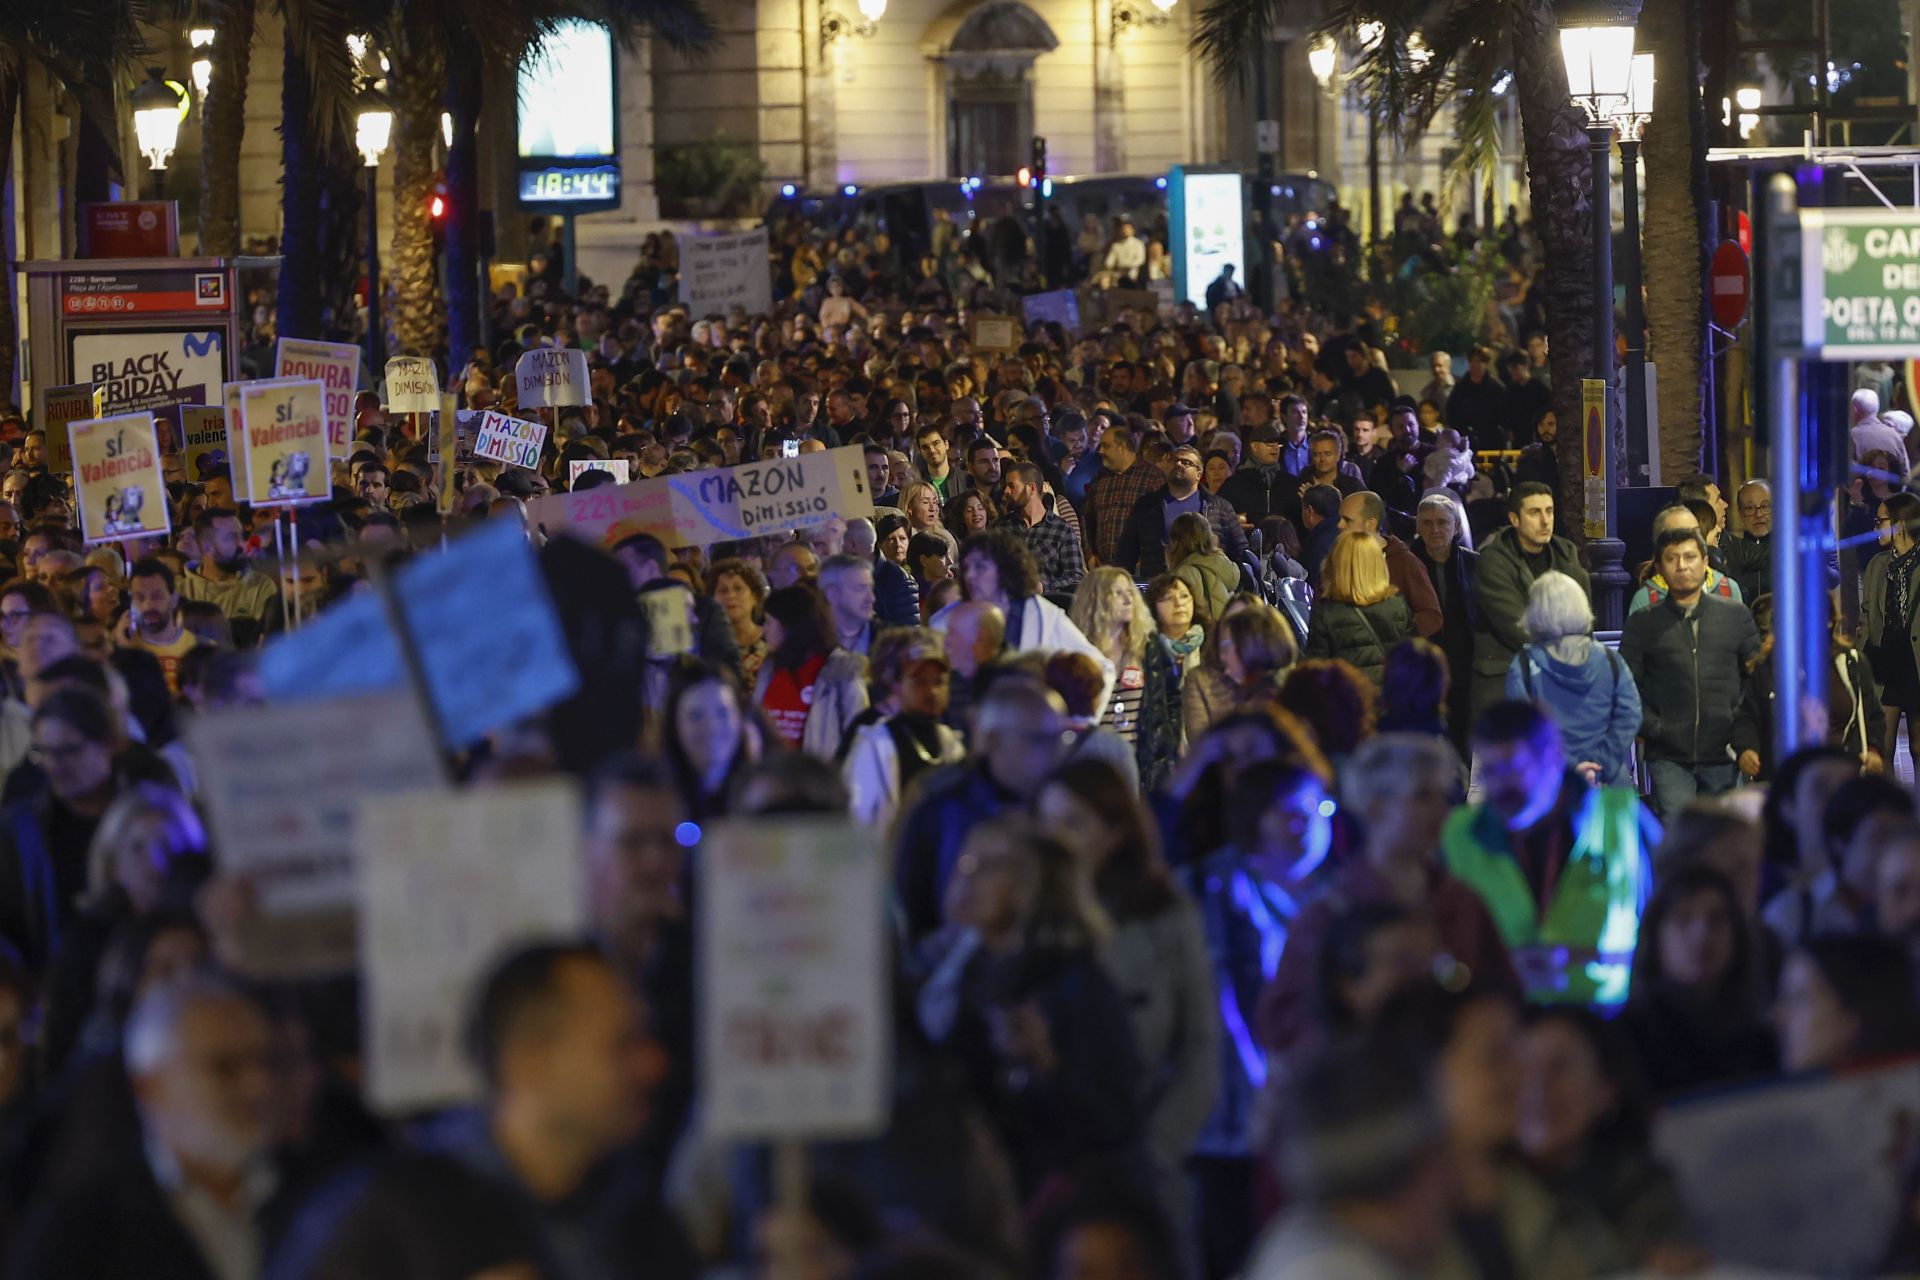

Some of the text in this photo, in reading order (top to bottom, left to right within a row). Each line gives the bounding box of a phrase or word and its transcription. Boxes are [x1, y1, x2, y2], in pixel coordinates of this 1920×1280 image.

[536, 172, 608, 196] 18:44
[1882, 263, 1920, 289] DE
[1823, 296, 1898, 327] POETA
[92, 350, 170, 383] BLACK
[282, 360, 351, 389] ROVIRA
[48, 400, 91, 421] ROVIRA
[187, 430, 227, 445] valenc
[485, 413, 543, 444] MAZÓN
[700, 461, 804, 504] MAZÓN
